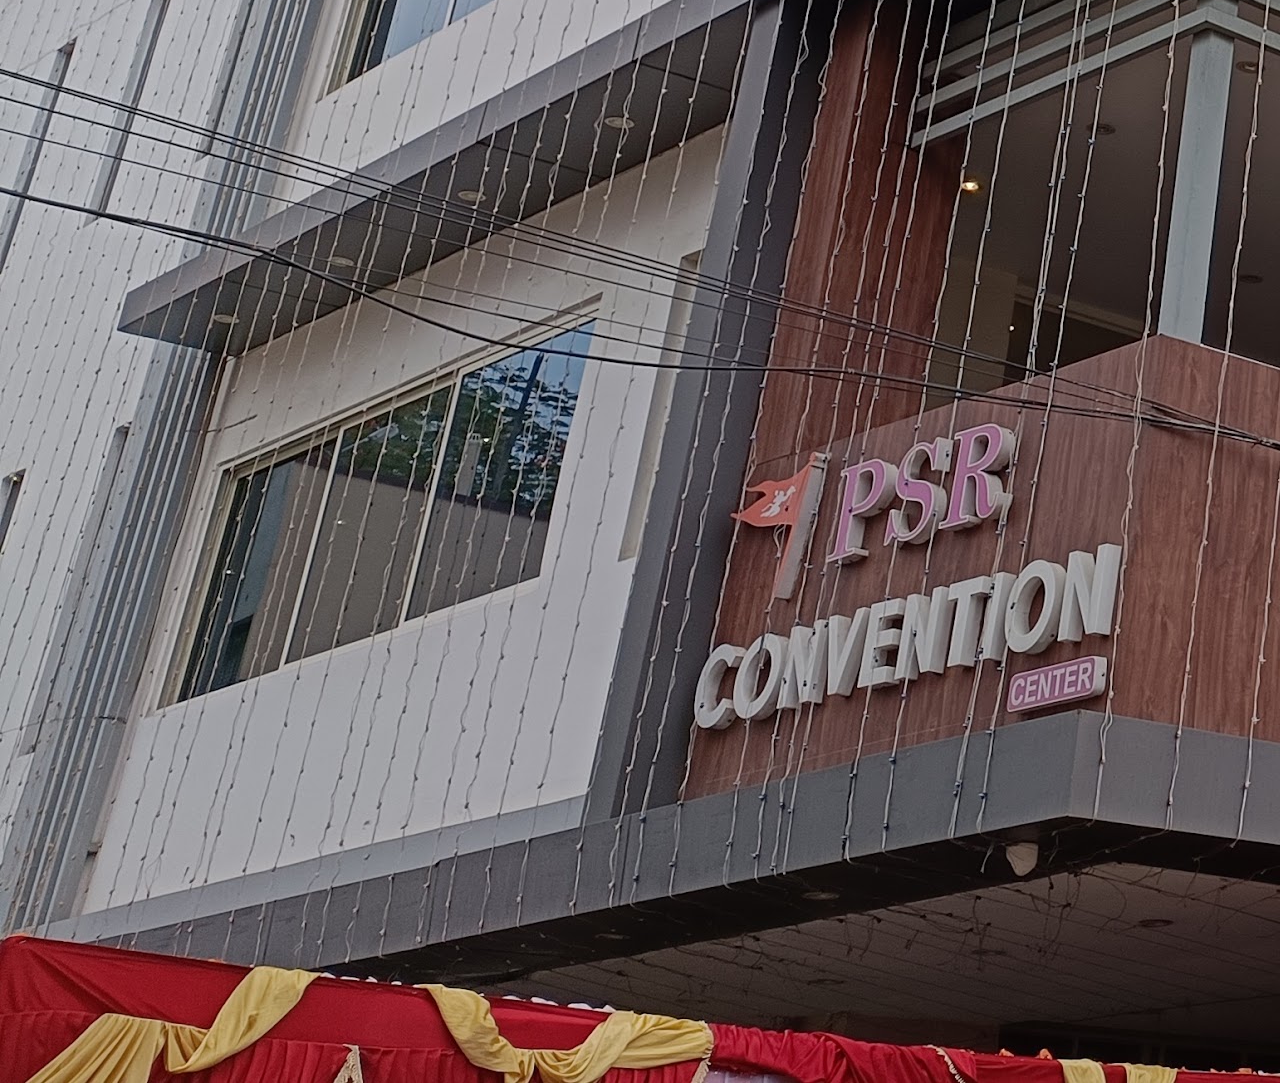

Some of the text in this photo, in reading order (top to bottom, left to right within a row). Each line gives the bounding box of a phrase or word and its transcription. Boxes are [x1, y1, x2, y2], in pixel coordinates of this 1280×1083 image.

[827, 423, 1014, 563] PSR
[694, 543, 1122, 730] CONVENTION
[1010, 661, 1093, 707] CENTER
